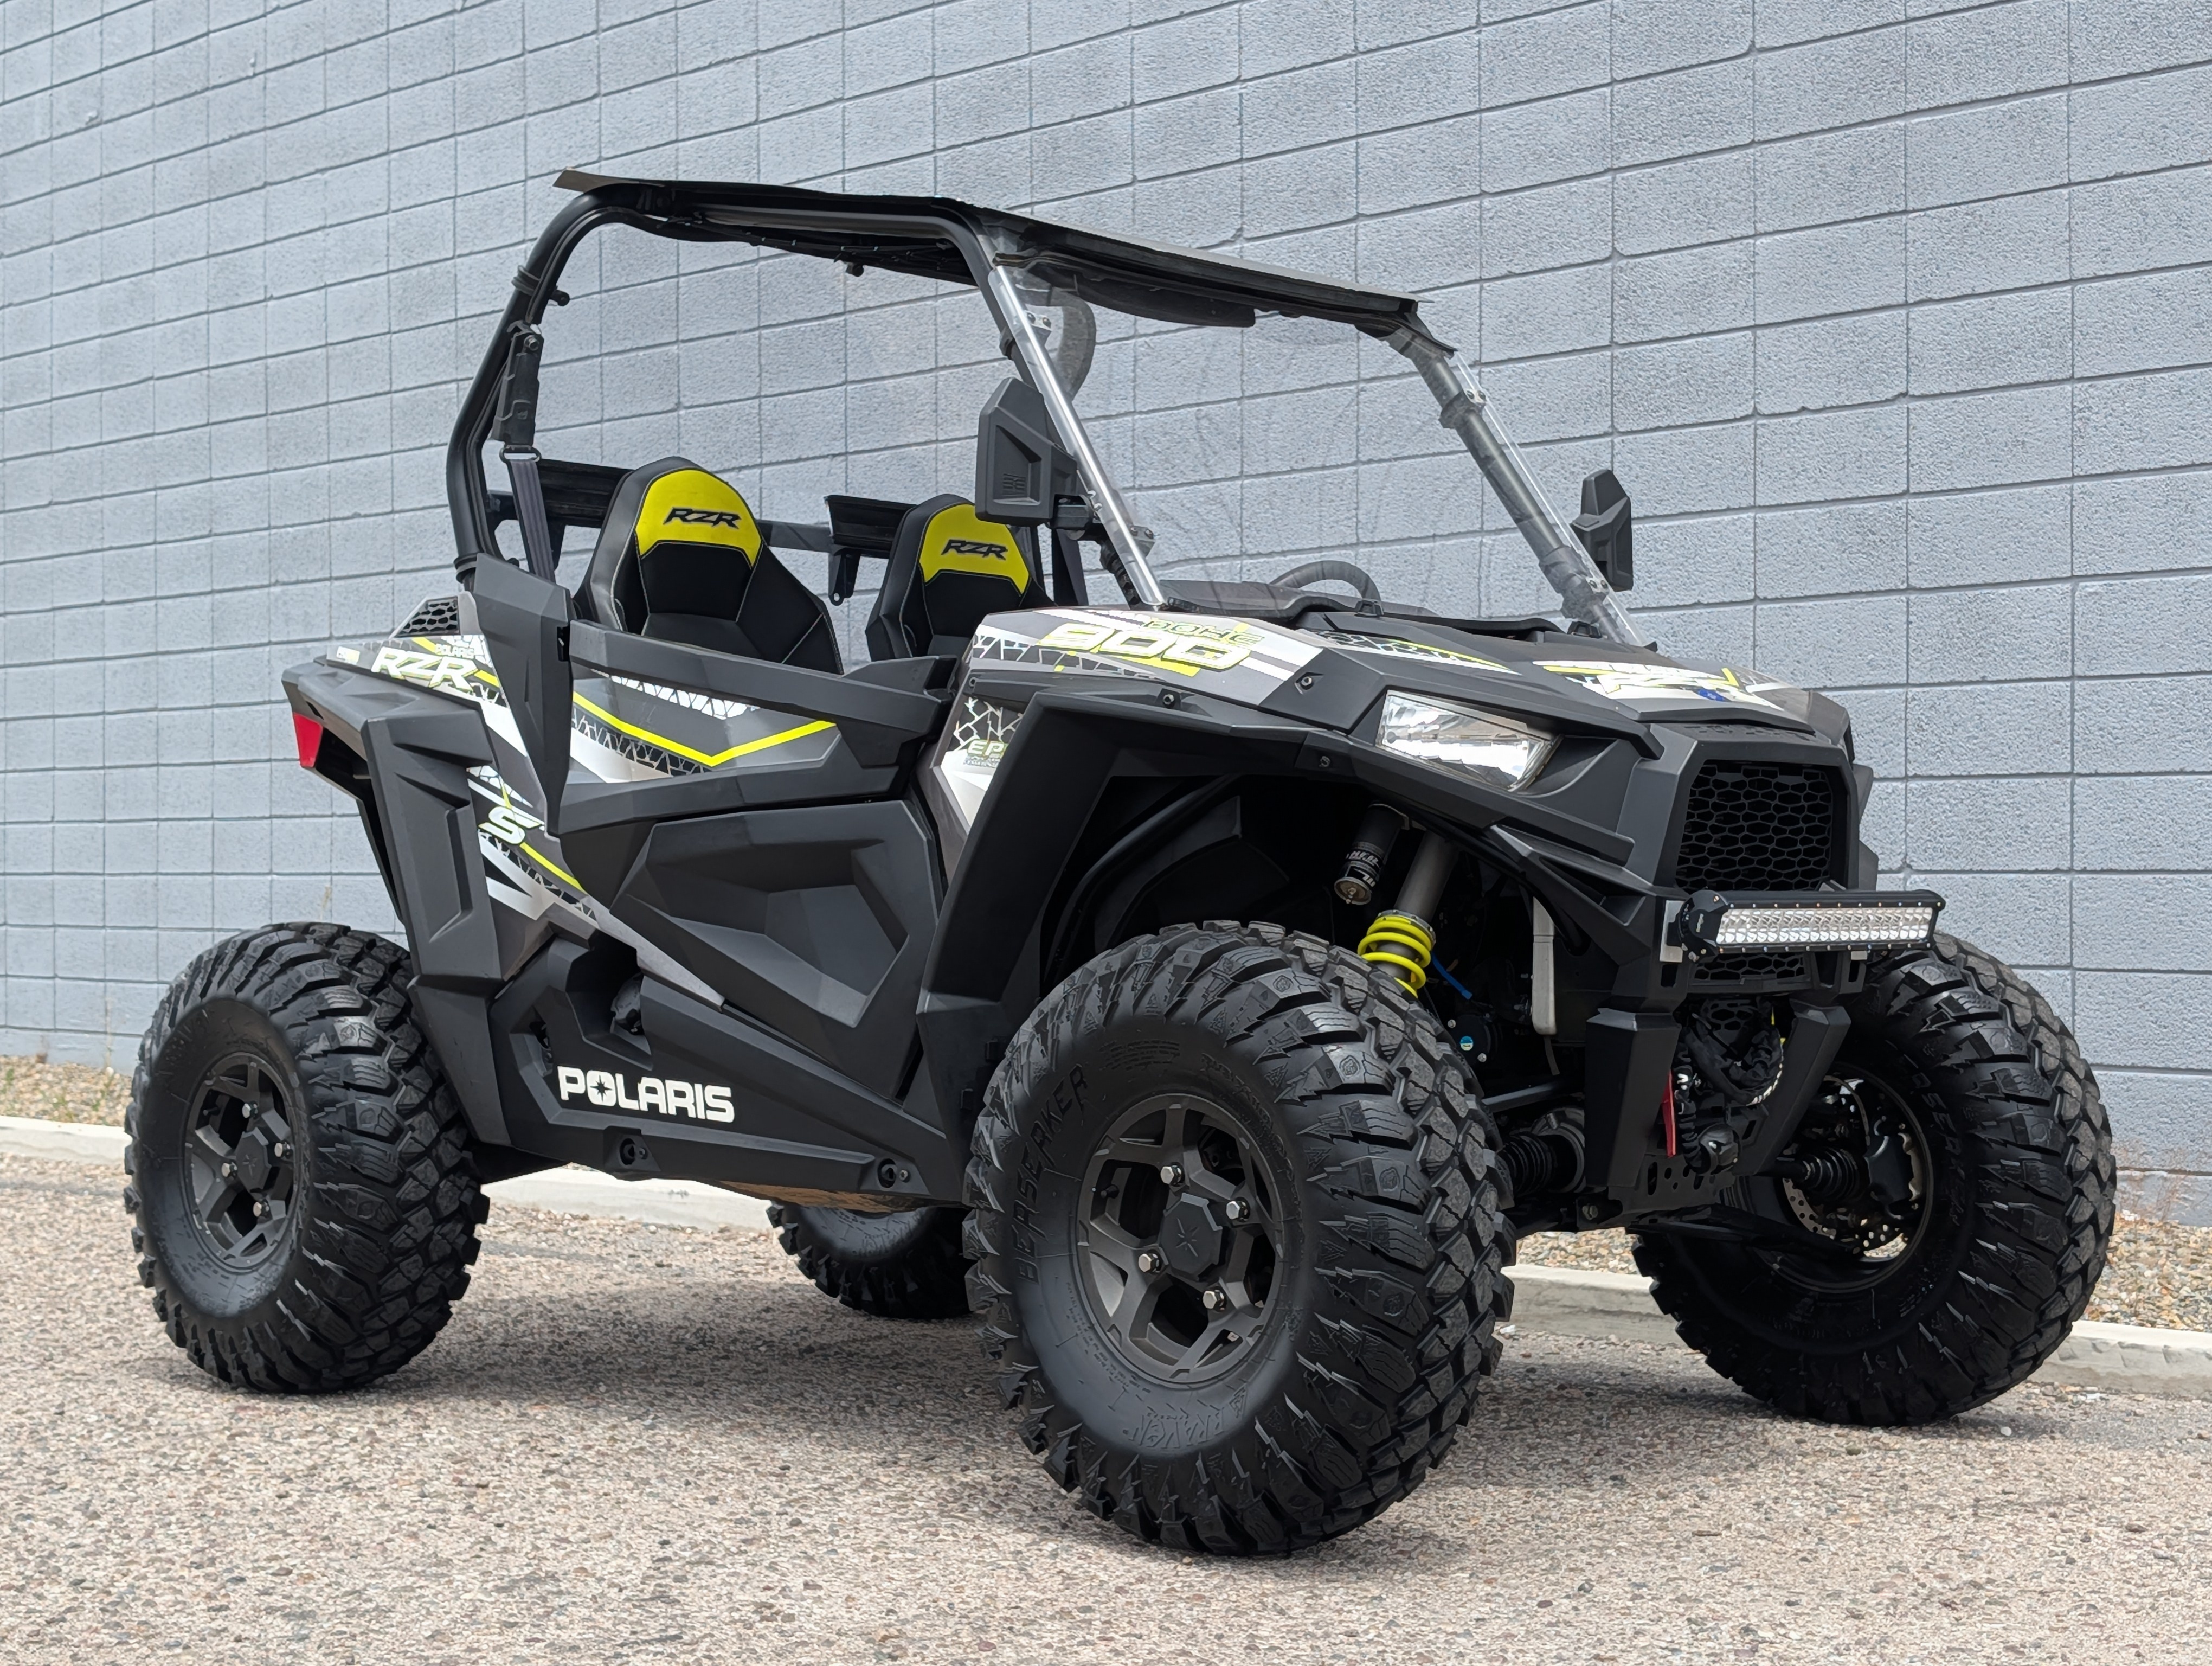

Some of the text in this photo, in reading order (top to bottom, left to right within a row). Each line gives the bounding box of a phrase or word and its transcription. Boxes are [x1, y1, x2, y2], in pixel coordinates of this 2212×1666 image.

[663, 507, 741, 529] RZR
[941, 540, 1008, 561] RZR
[371, 646, 478, 693] RZR
[968, 740, 1006, 756] EP
[478, 806, 541, 844] S
[557, 1066, 735, 1123] POLARIS
